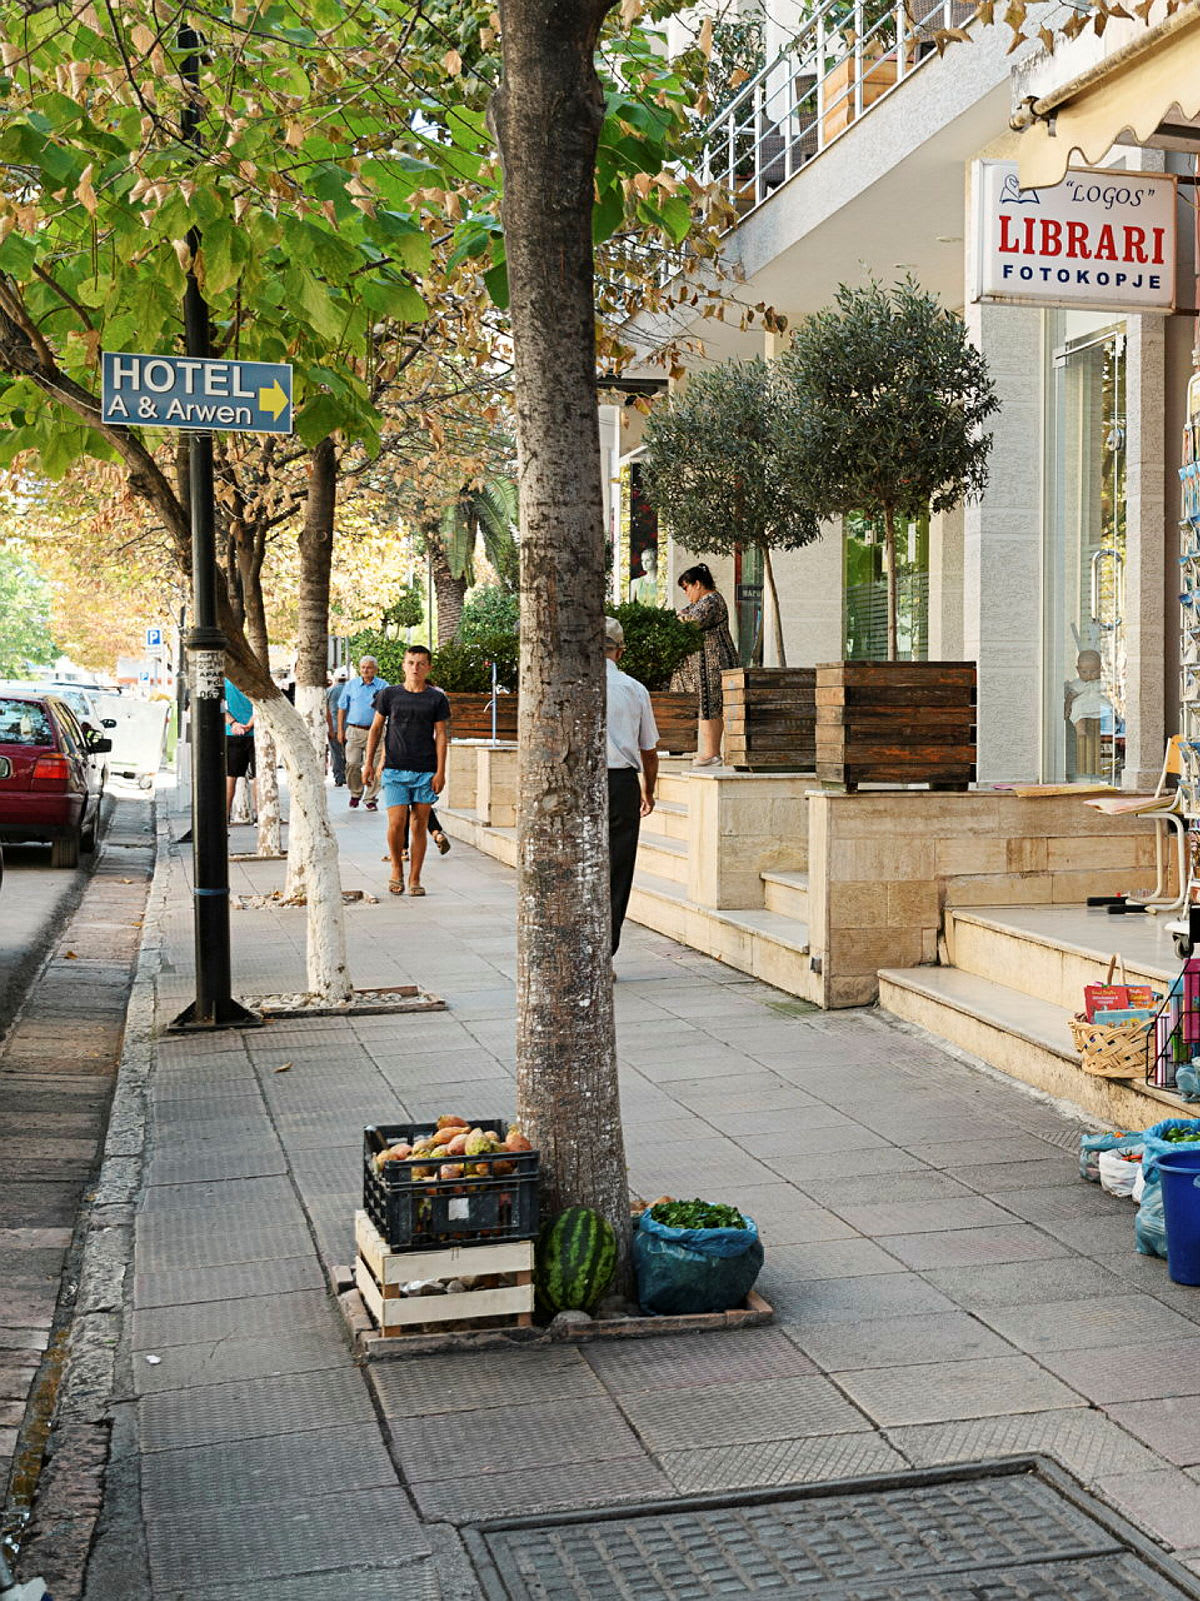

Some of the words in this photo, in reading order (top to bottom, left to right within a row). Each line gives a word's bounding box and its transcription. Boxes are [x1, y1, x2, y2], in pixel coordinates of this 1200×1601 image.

[998, 215, 1165, 265] LIBRARI
[1003, 264, 1161, 289] FOTOKOPJE
[112, 357, 256, 399] HOTEL
[107, 395, 129, 418] A
[137, 396, 158, 419] &
[165, 398, 252, 425] Arwen
